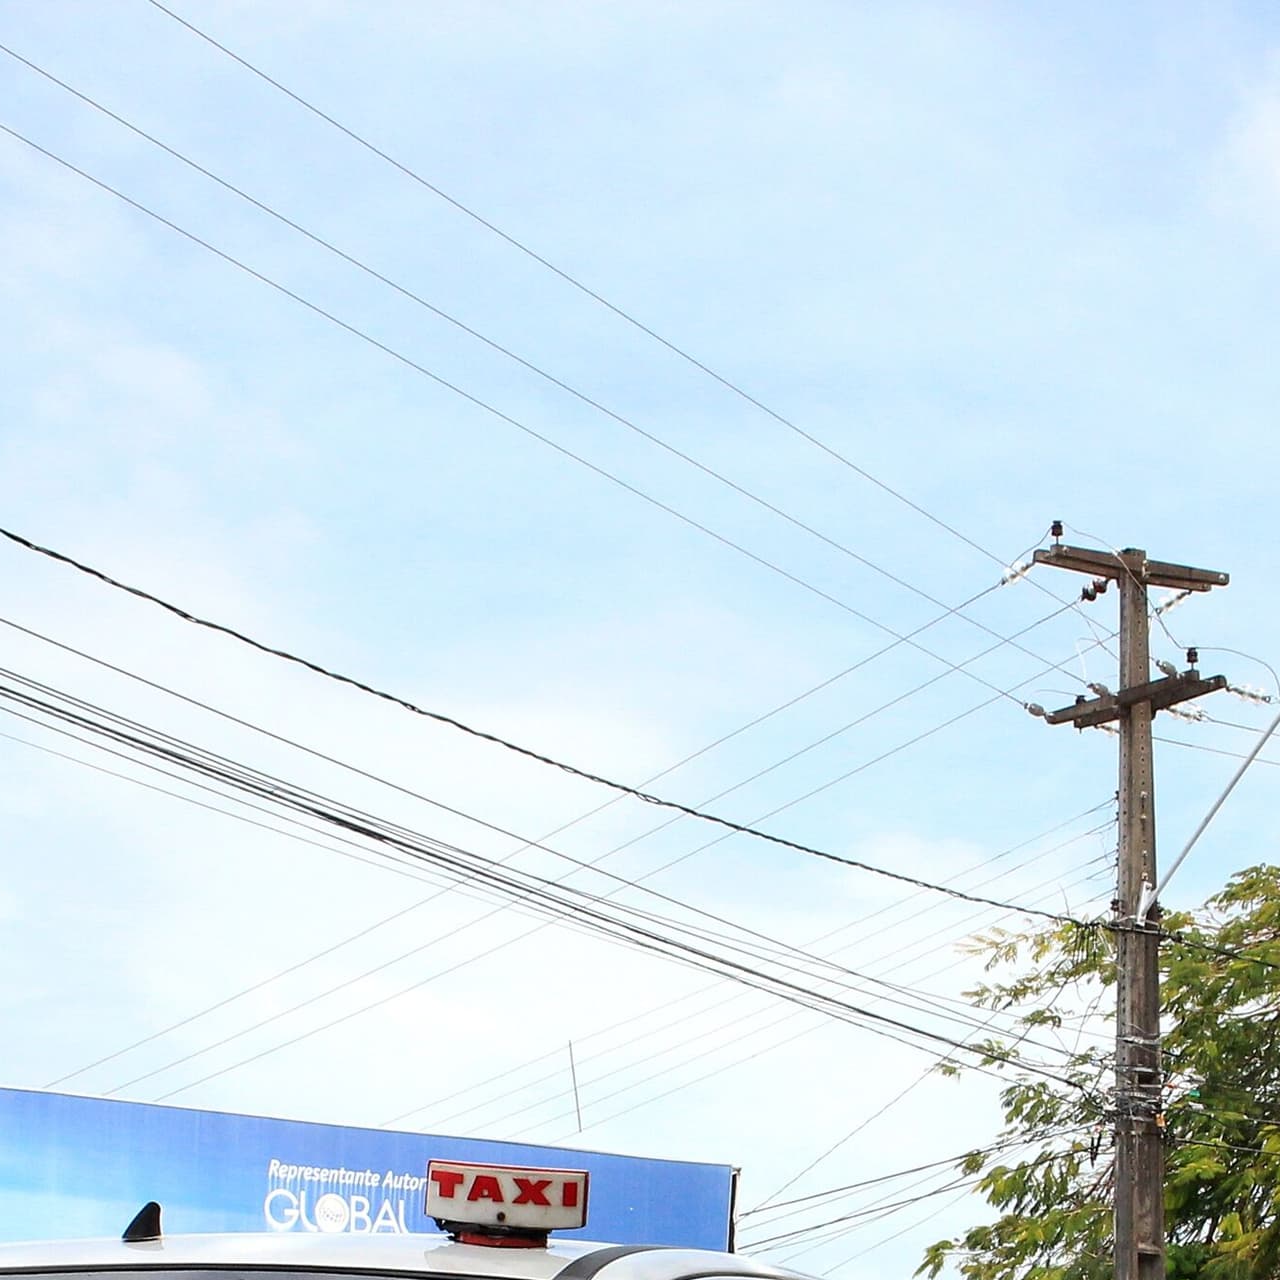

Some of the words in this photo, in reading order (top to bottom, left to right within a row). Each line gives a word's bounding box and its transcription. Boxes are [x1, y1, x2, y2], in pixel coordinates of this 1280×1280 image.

[269, 1159, 380, 1188] Representante
[430, 1170, 578, 1208] TAXI
[264, 1189, 408, 1234] GLOBAL
